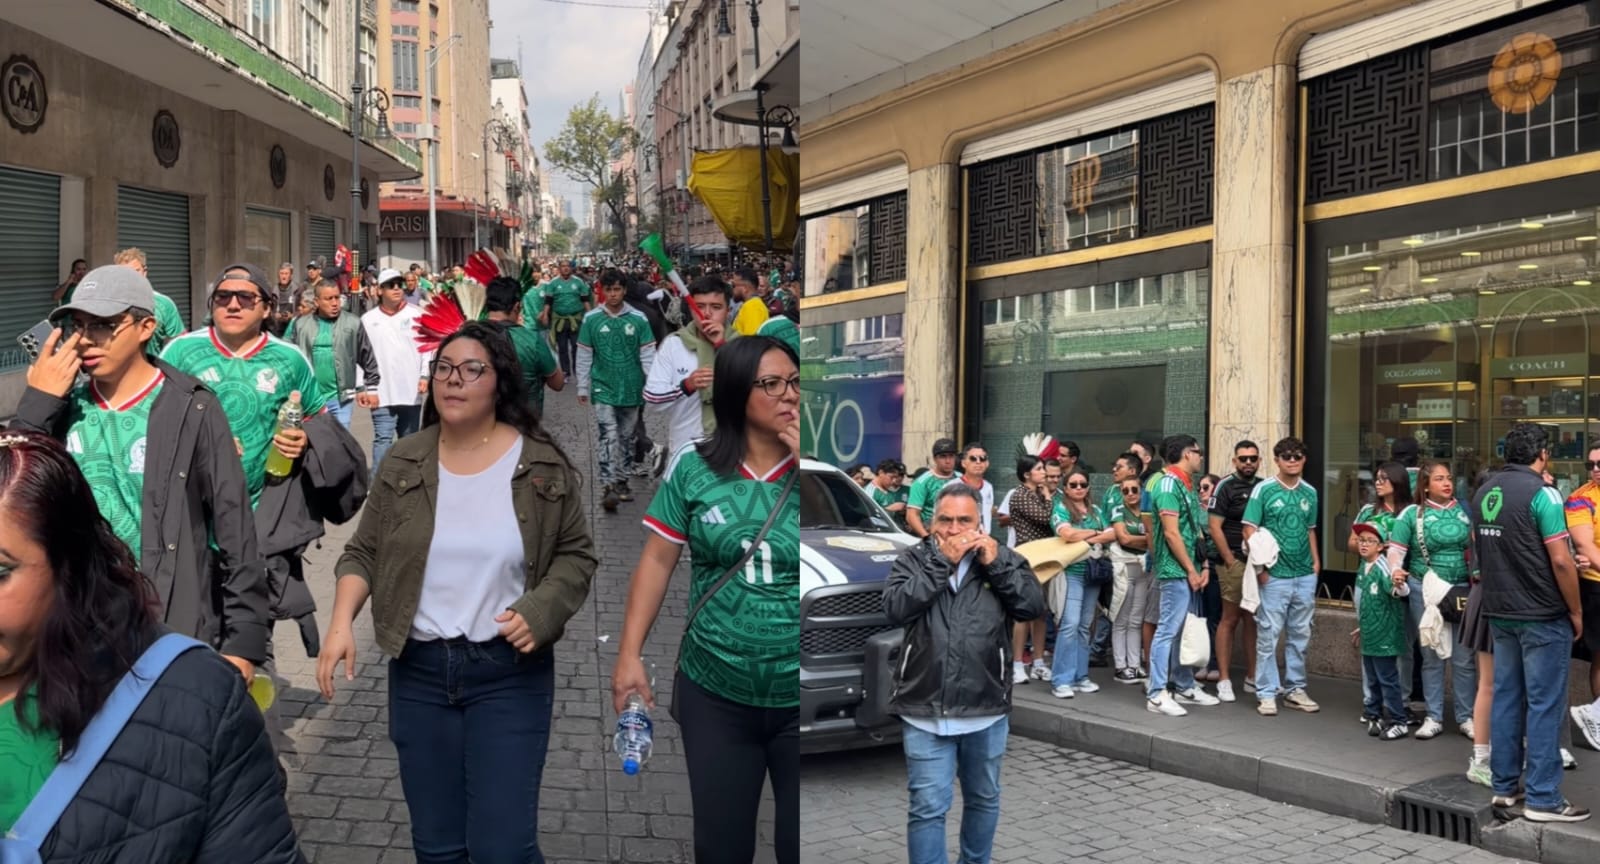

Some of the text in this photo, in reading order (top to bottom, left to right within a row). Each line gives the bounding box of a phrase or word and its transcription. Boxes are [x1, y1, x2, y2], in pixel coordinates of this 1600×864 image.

[8, 75, 39, 112] C&A
[380, 214, 440, 233] ARISI
[1509, 360, 1566, 371] COACH
[740, 539, 773, 584] 11
